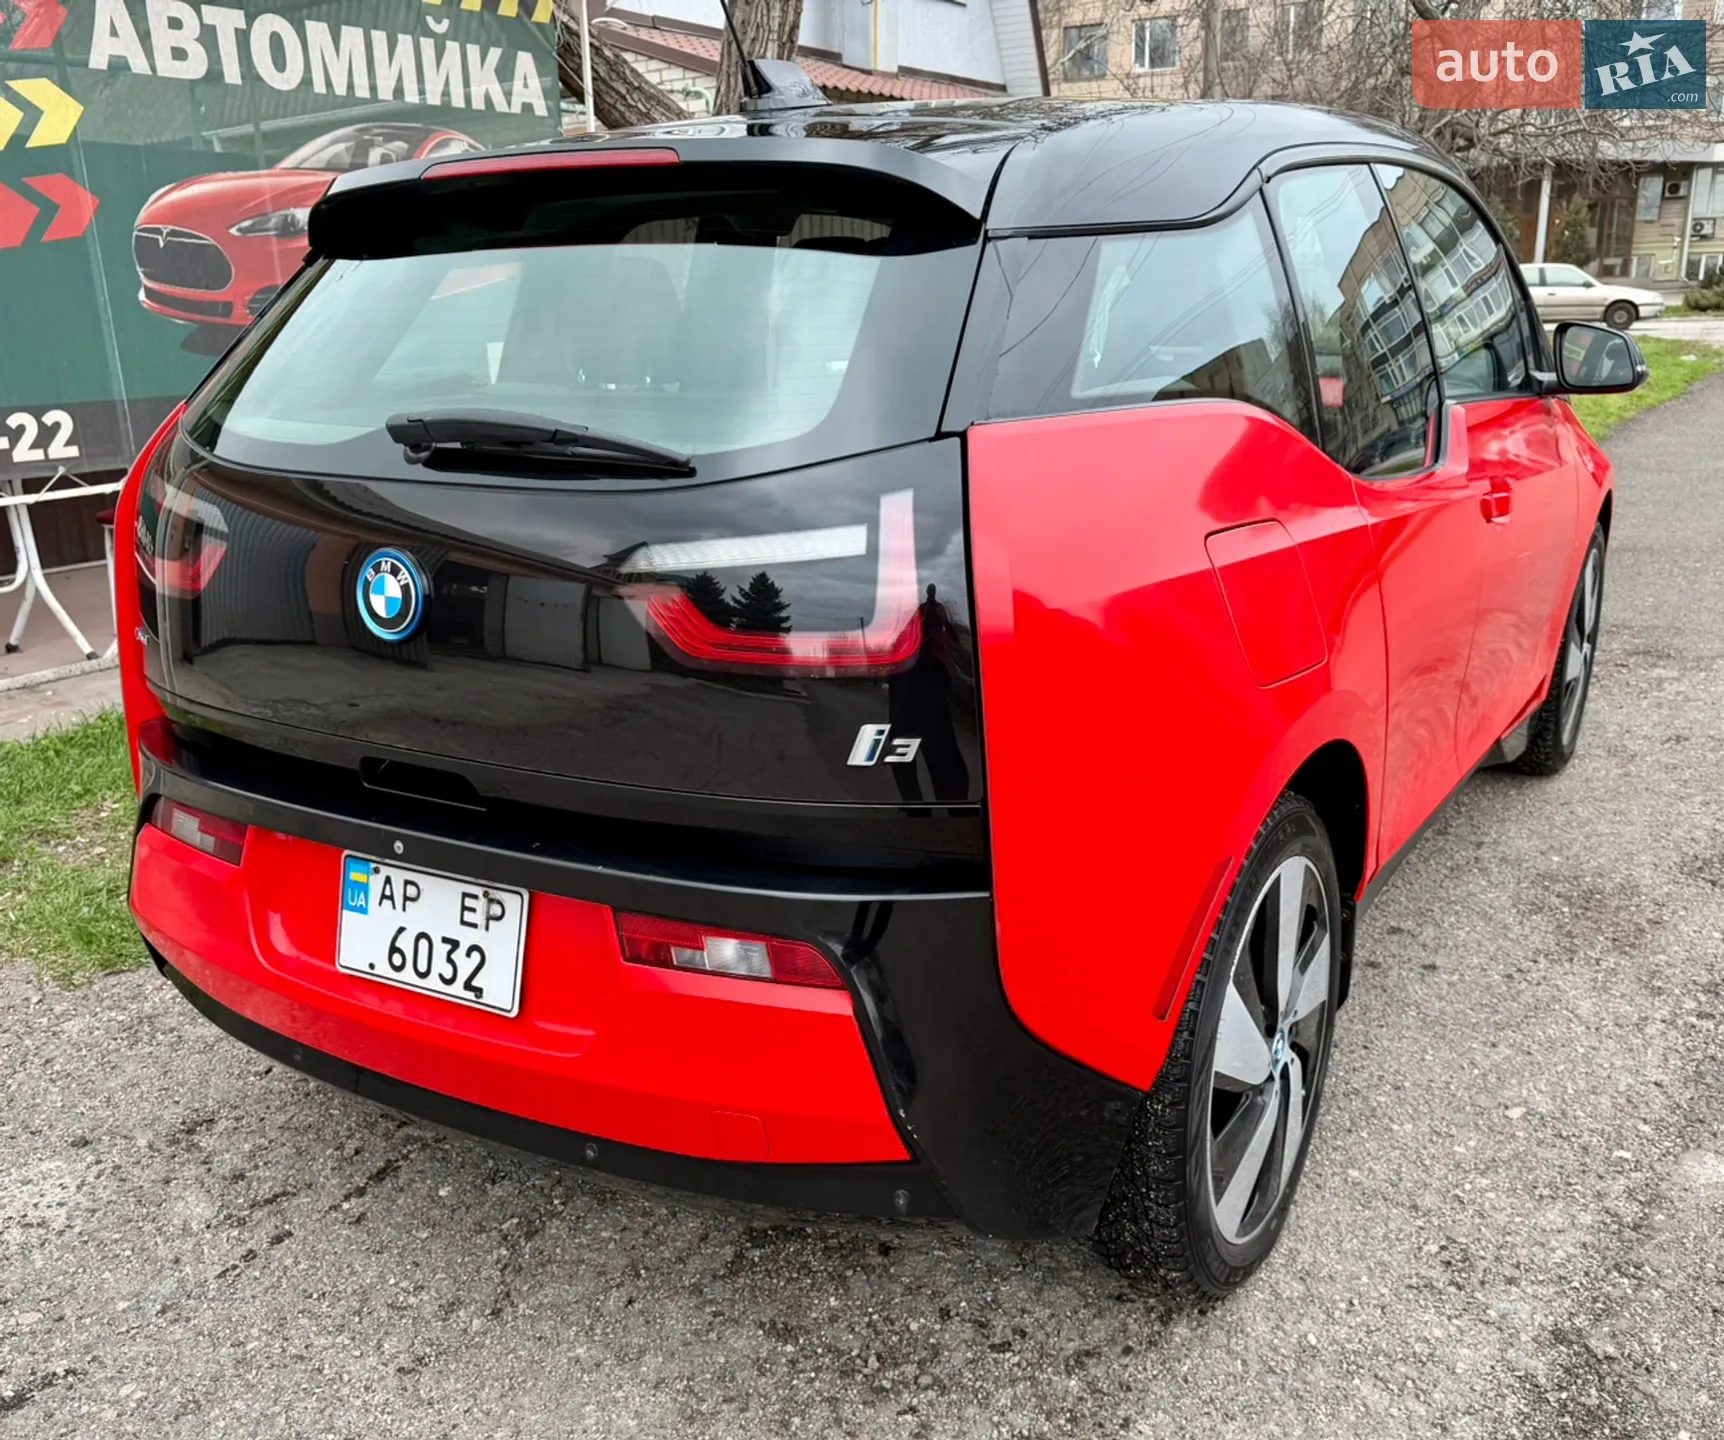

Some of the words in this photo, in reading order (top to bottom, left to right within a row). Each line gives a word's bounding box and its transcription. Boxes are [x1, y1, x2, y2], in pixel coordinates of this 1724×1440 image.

[88, 0, 549, 118] АВТОМИЙКА
[365, 561, 409, 586] BMW
[846, 724, 922, 766] i3
[349, 888, 367, 908] UA
[378, 875, 421, 912] AP
[459, 891, 506, 931] EP
[387, 926, 487, 997] 6032
